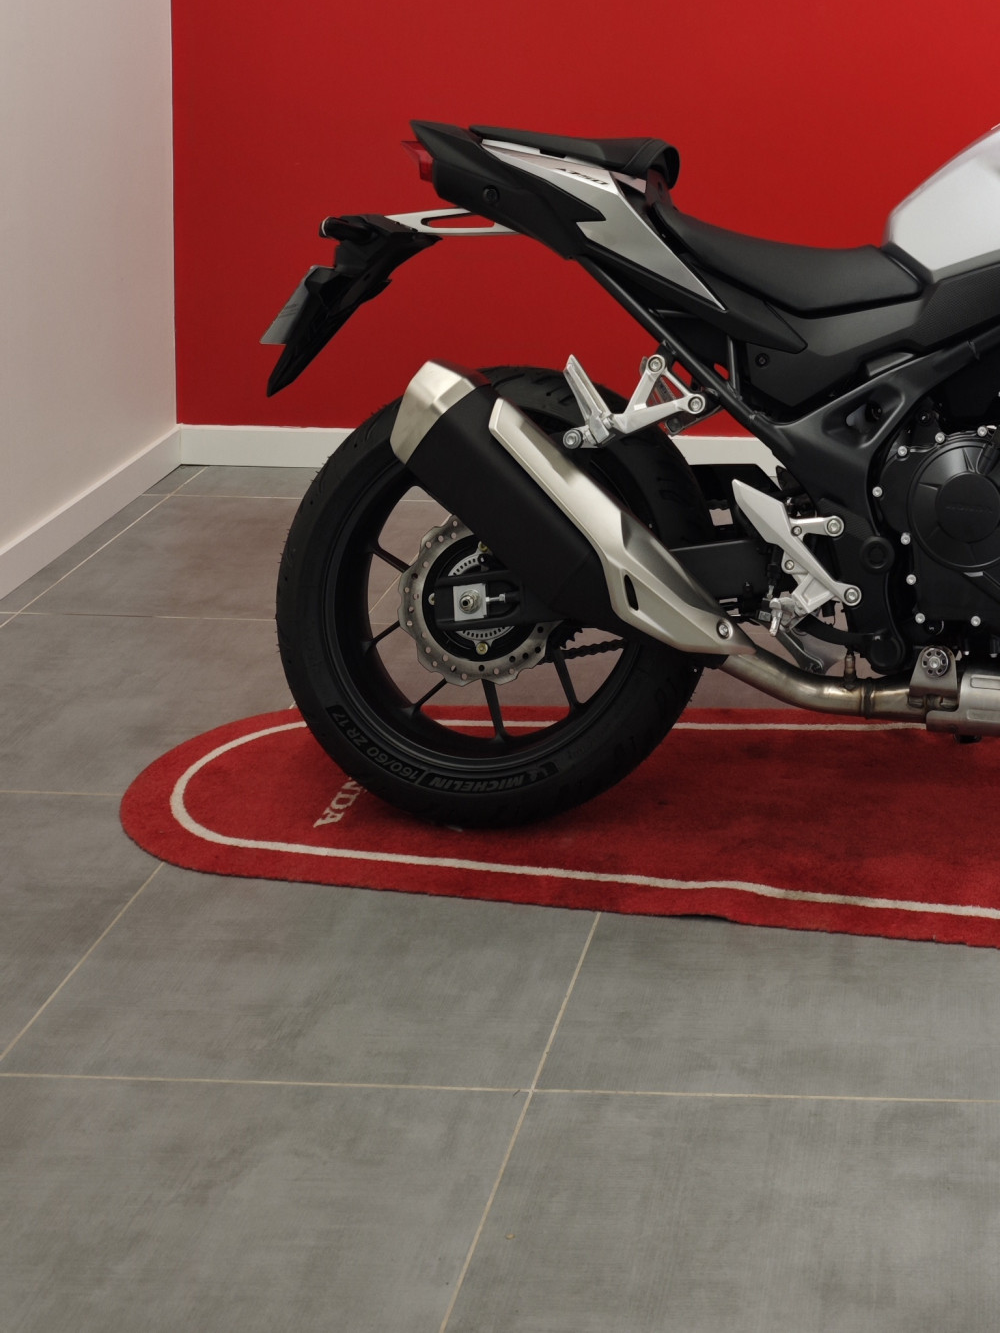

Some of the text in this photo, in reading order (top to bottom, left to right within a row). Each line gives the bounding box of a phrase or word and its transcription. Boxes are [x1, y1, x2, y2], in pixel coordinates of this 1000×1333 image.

[330, 712, 525, 793] MICHELIN 160/60 ZR 17
[312, 777, 368, 828] NDA
